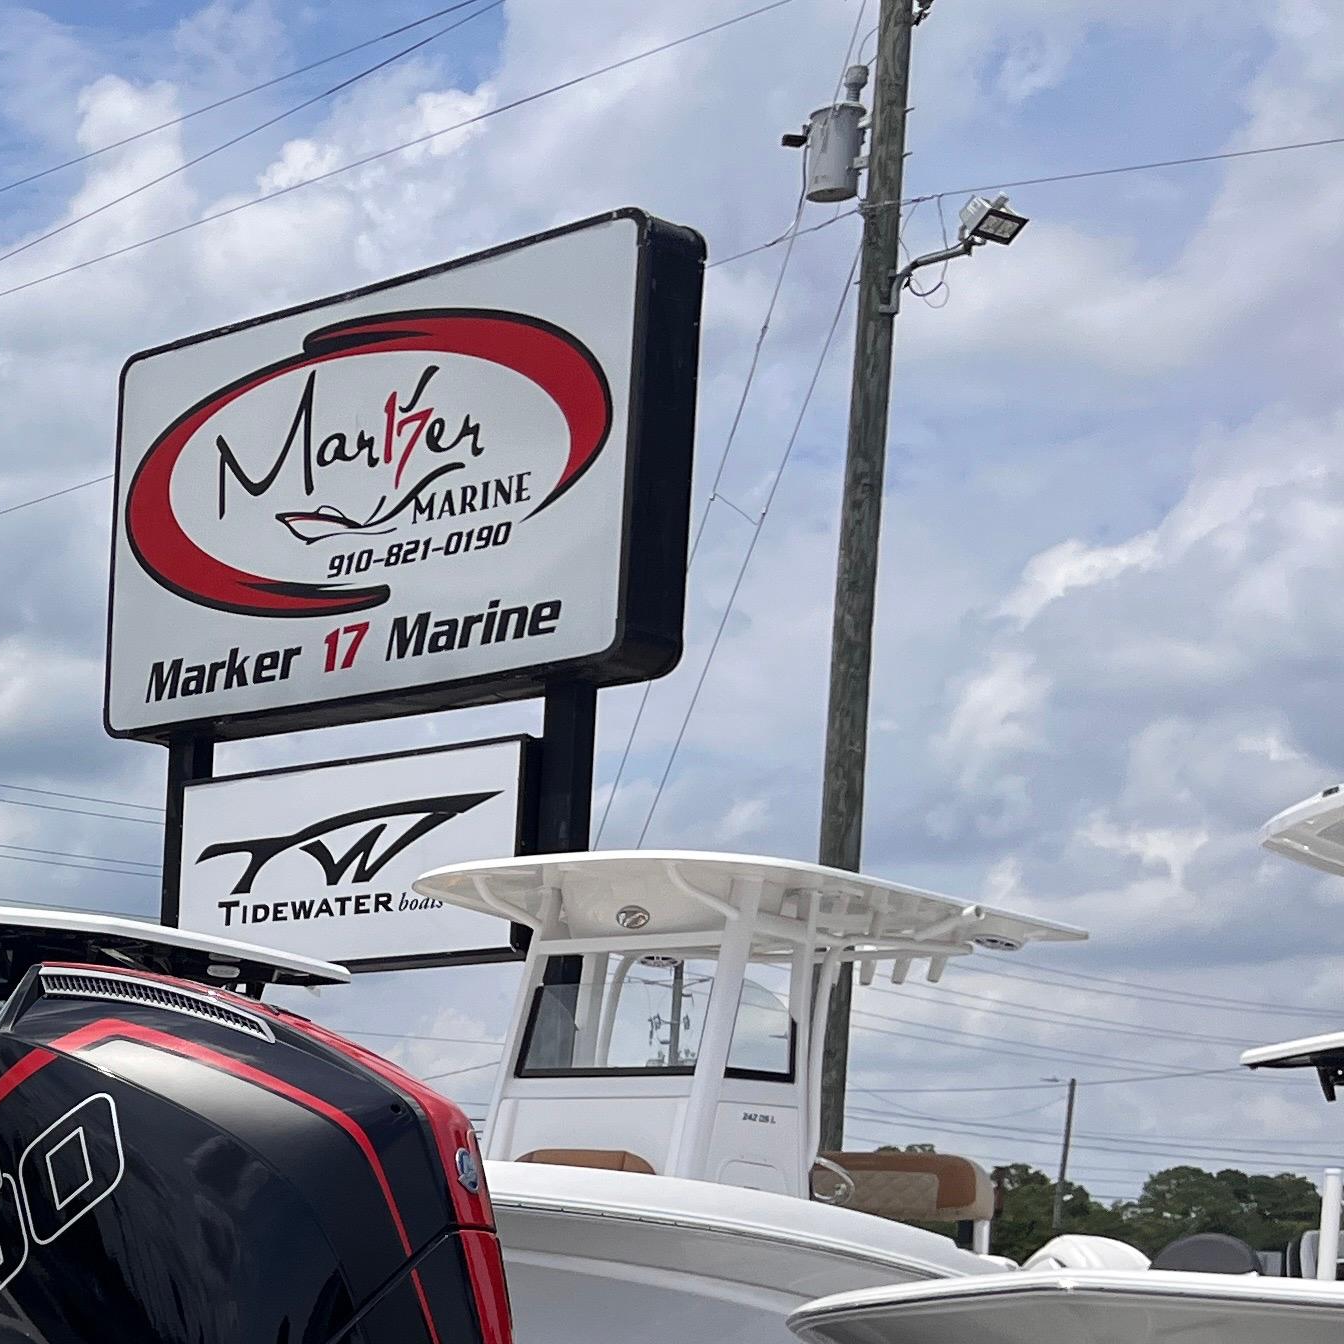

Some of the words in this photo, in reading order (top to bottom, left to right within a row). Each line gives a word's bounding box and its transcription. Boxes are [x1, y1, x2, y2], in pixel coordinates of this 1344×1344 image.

[411, 471, 532, 525] MARINE
[326, 521, 513, 579] 910-821-0190
[145, 646, 303, 704] Marker
[323, 621, 371, 673] 17
[385, 599, 563, 662] Marine
[217, 892, 394, 927] TIDEWATER
